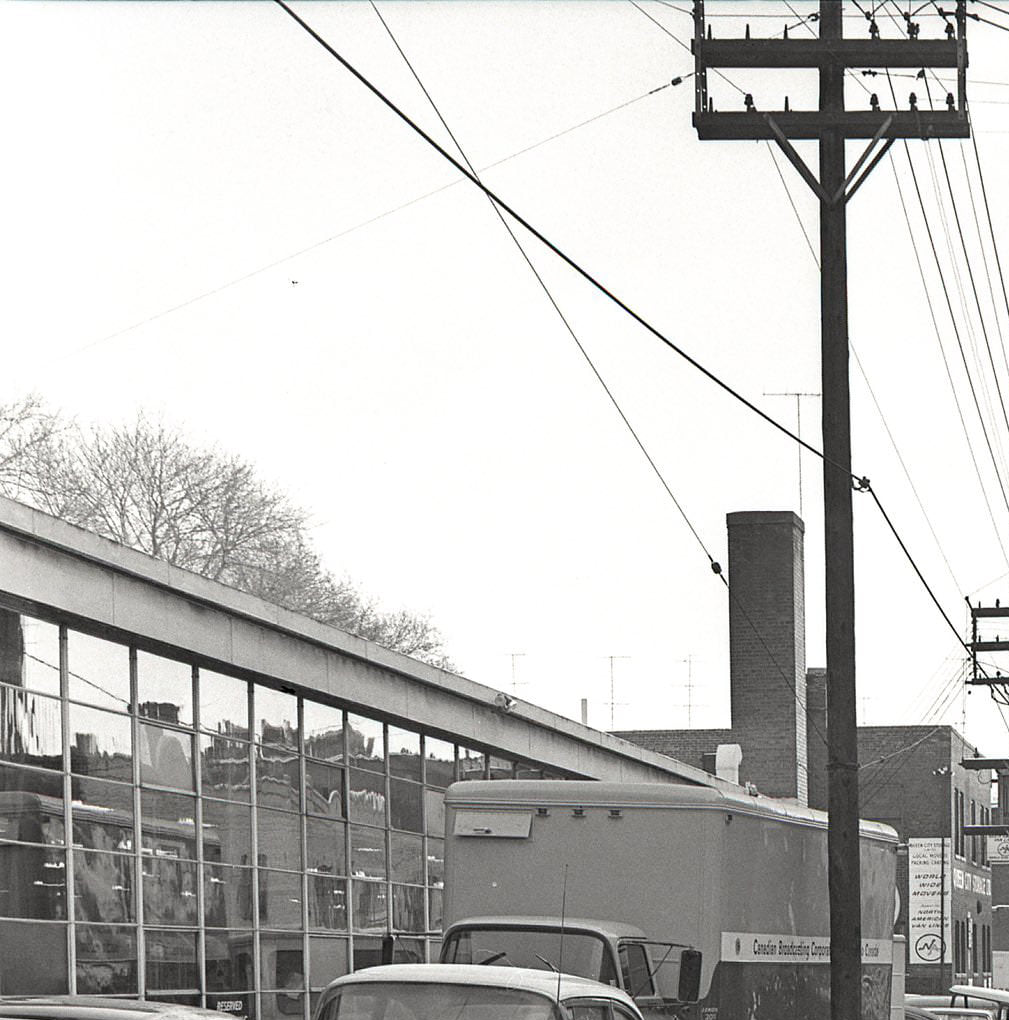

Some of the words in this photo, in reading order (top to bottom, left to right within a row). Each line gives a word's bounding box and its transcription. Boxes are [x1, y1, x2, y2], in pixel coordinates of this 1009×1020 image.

[753, 938, 777, 955] Canadian
[778, 940, 810, 961] Broadcasting
[217, 1000, 243, 1011] RESERVED
